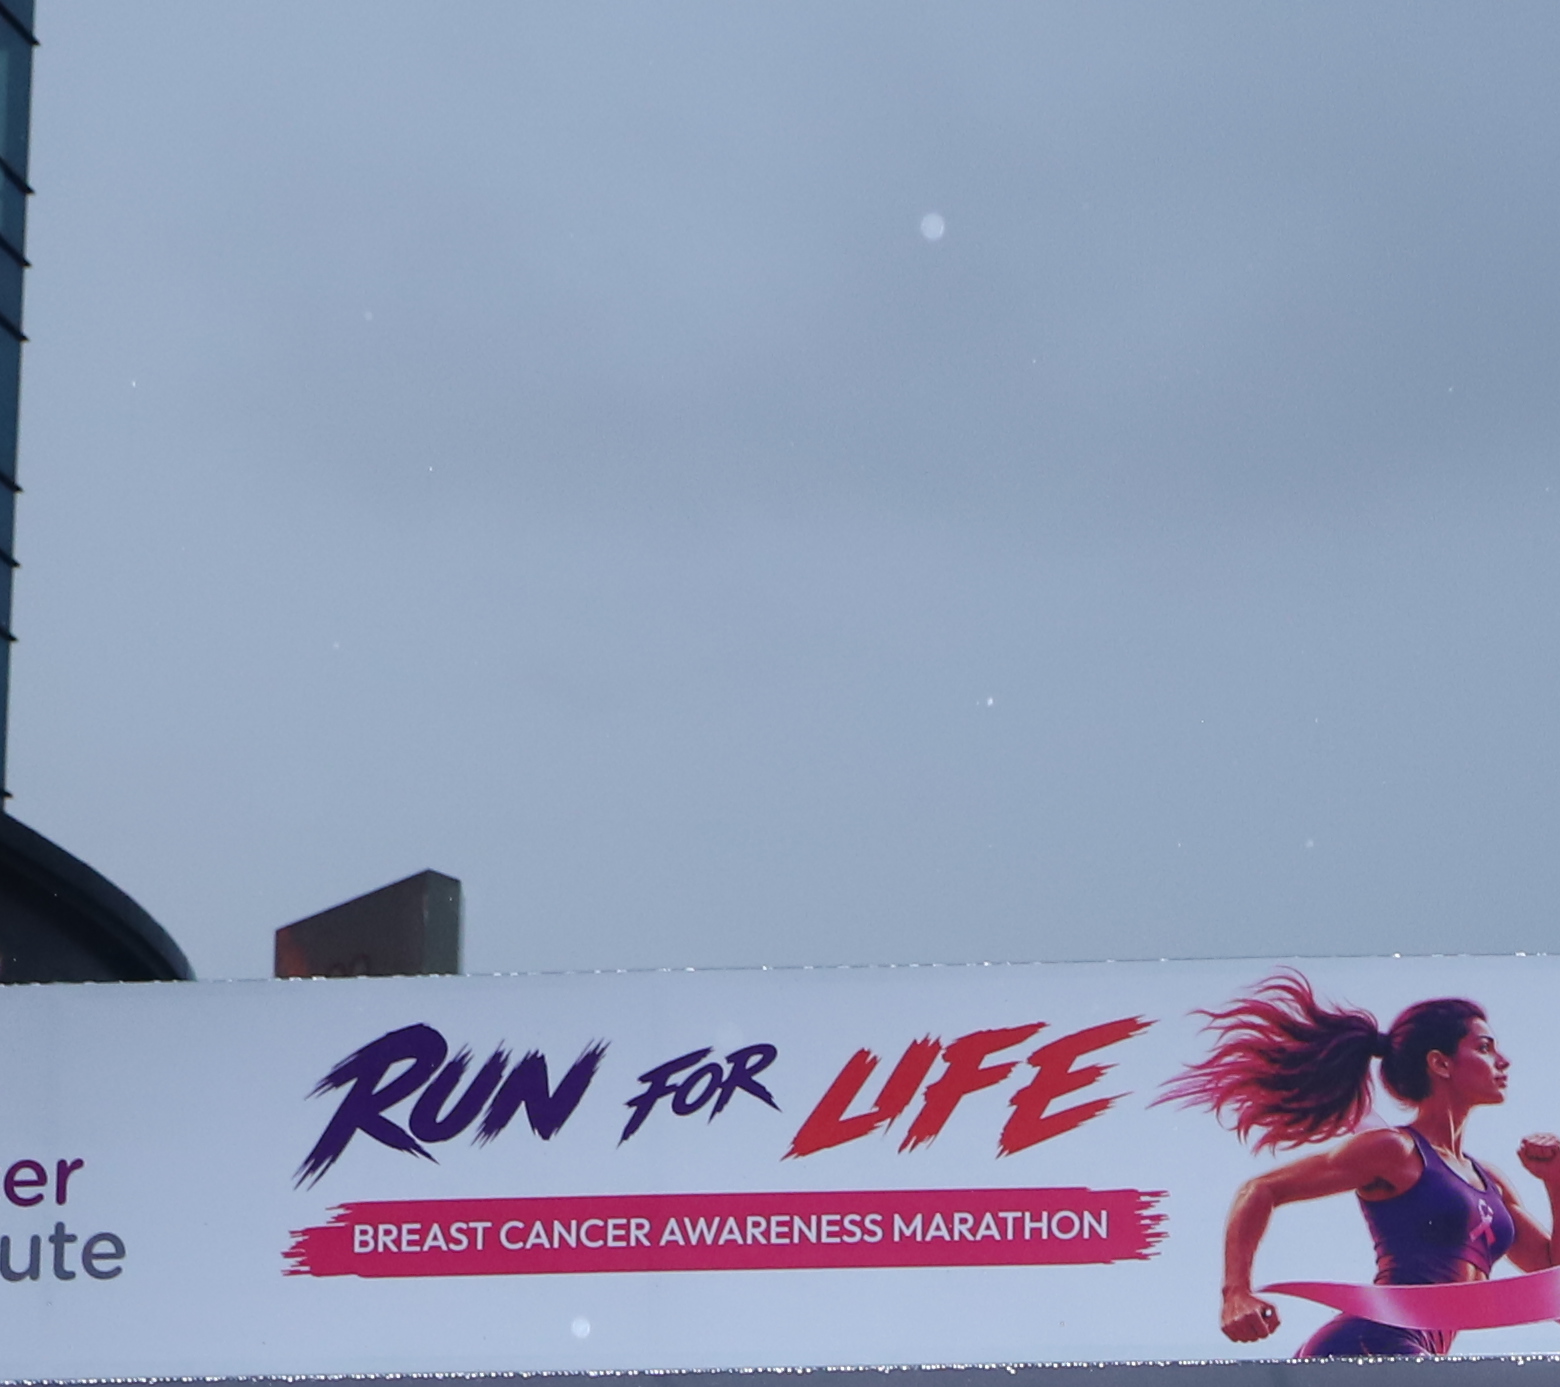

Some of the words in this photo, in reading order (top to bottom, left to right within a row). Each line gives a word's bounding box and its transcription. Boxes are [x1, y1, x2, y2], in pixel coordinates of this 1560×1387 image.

[293, 1023, 611, 1190] RUN
[619, 1044, 781, 1146] FOR
[781, 1016, 1156, 1160] LIFE
[353, 1220, 491, 1255] BREAST
[499, 1217, 651, 1252] CANCER
[660, 1213, 884, 1249] AWARENESS
[892, 1210, 1109, 1243] MARATHON
